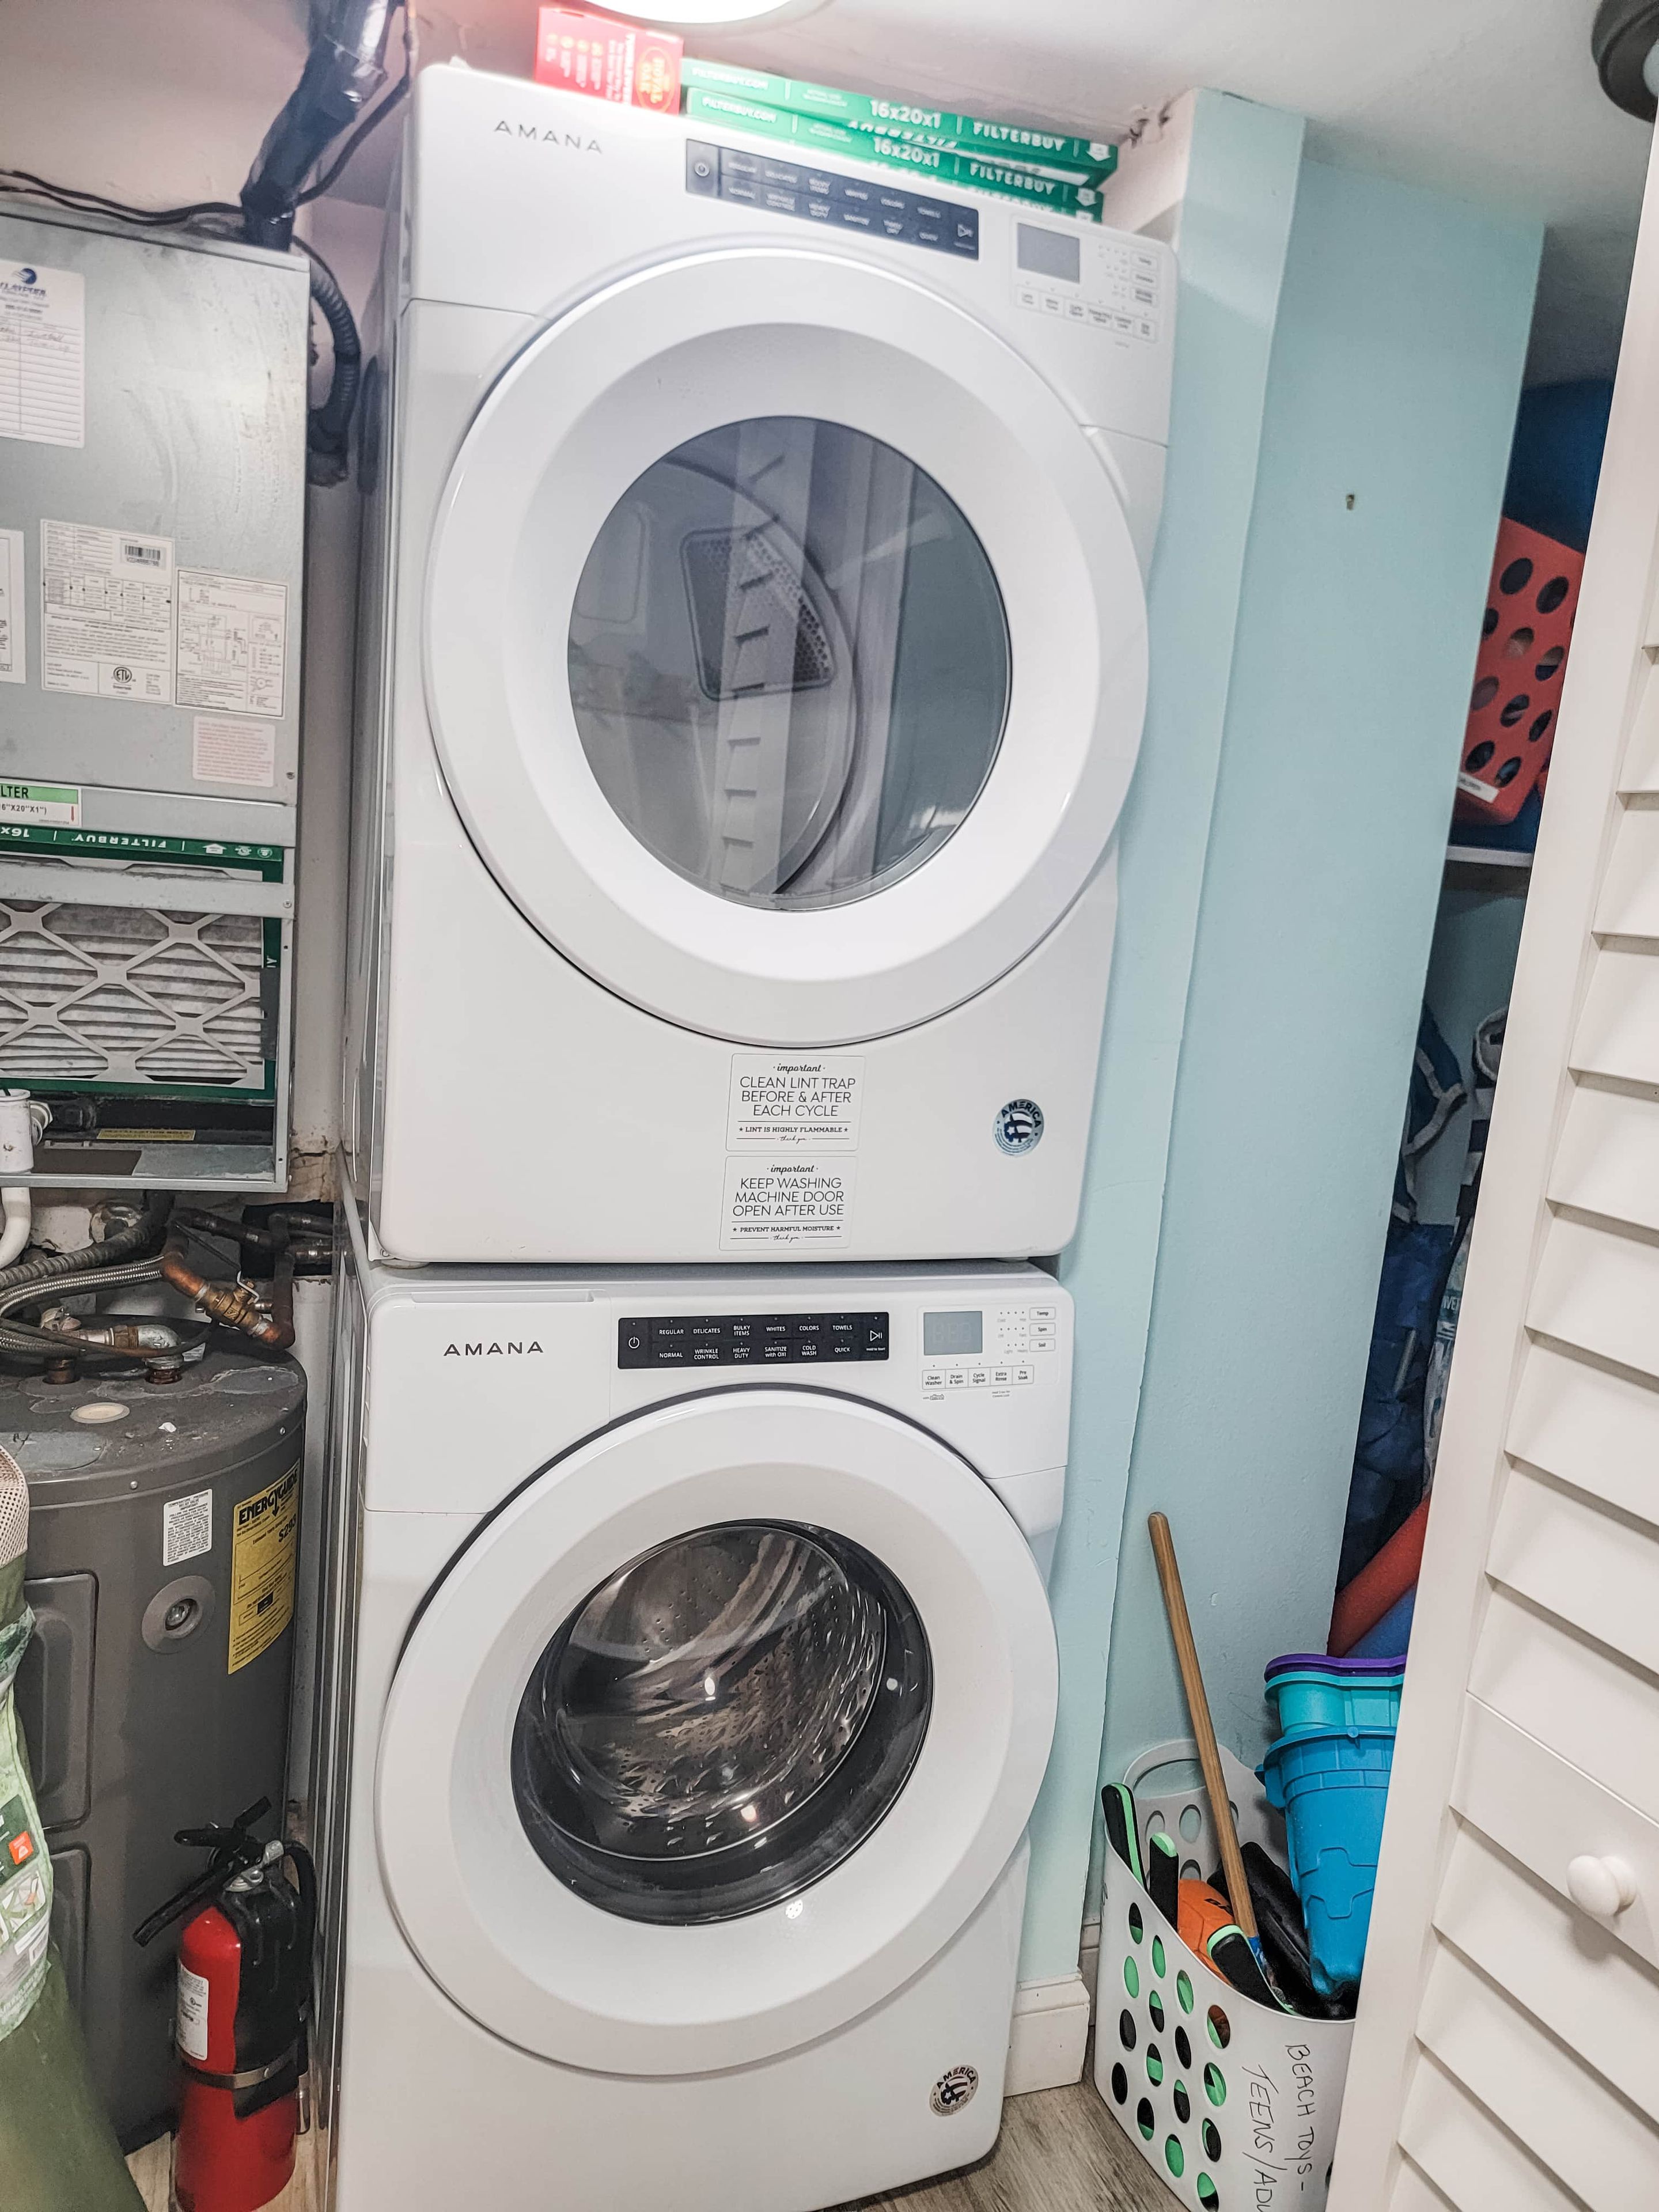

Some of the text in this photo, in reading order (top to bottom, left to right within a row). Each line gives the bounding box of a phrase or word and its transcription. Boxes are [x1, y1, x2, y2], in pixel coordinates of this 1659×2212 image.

[870, 100, 941, 129] 16x20x1
[494, 120, 603, 154] AMANA
[973, 122, 1066, 151] FILTERBUY
[874, 137, 941, 168] 16x20x1
[970, 162, 1056, 195] FILTERBUY
[74, 834, 166, 848] FILTERBUY
[777, 1063, 821, 1074] important
[740, 1077, 855, 1089] CLEAN LINT TRAP
[741, 1090, 851, 1103] BEFORE & AFTER
[753, 1105, 839, 1116] EACH CYCLE
[1001, 1101, 1041, 1128] AMERICA
[770, 1164, 815, 1175] important
[741, 1177, 842, 1189] KEEP WASHING
[735, 1191, 844, 1203] MACHINE DOOR
[733, 1204, 844, 1216] OPEN AFTER USE
[443, 1341, 544, 1357] AMANA
[937, 2067, 976, 2089] AMERICA
[1285, 2044, 1315, 2116] BEACH
[1284, 2126, 1314, 2175] TOYS
